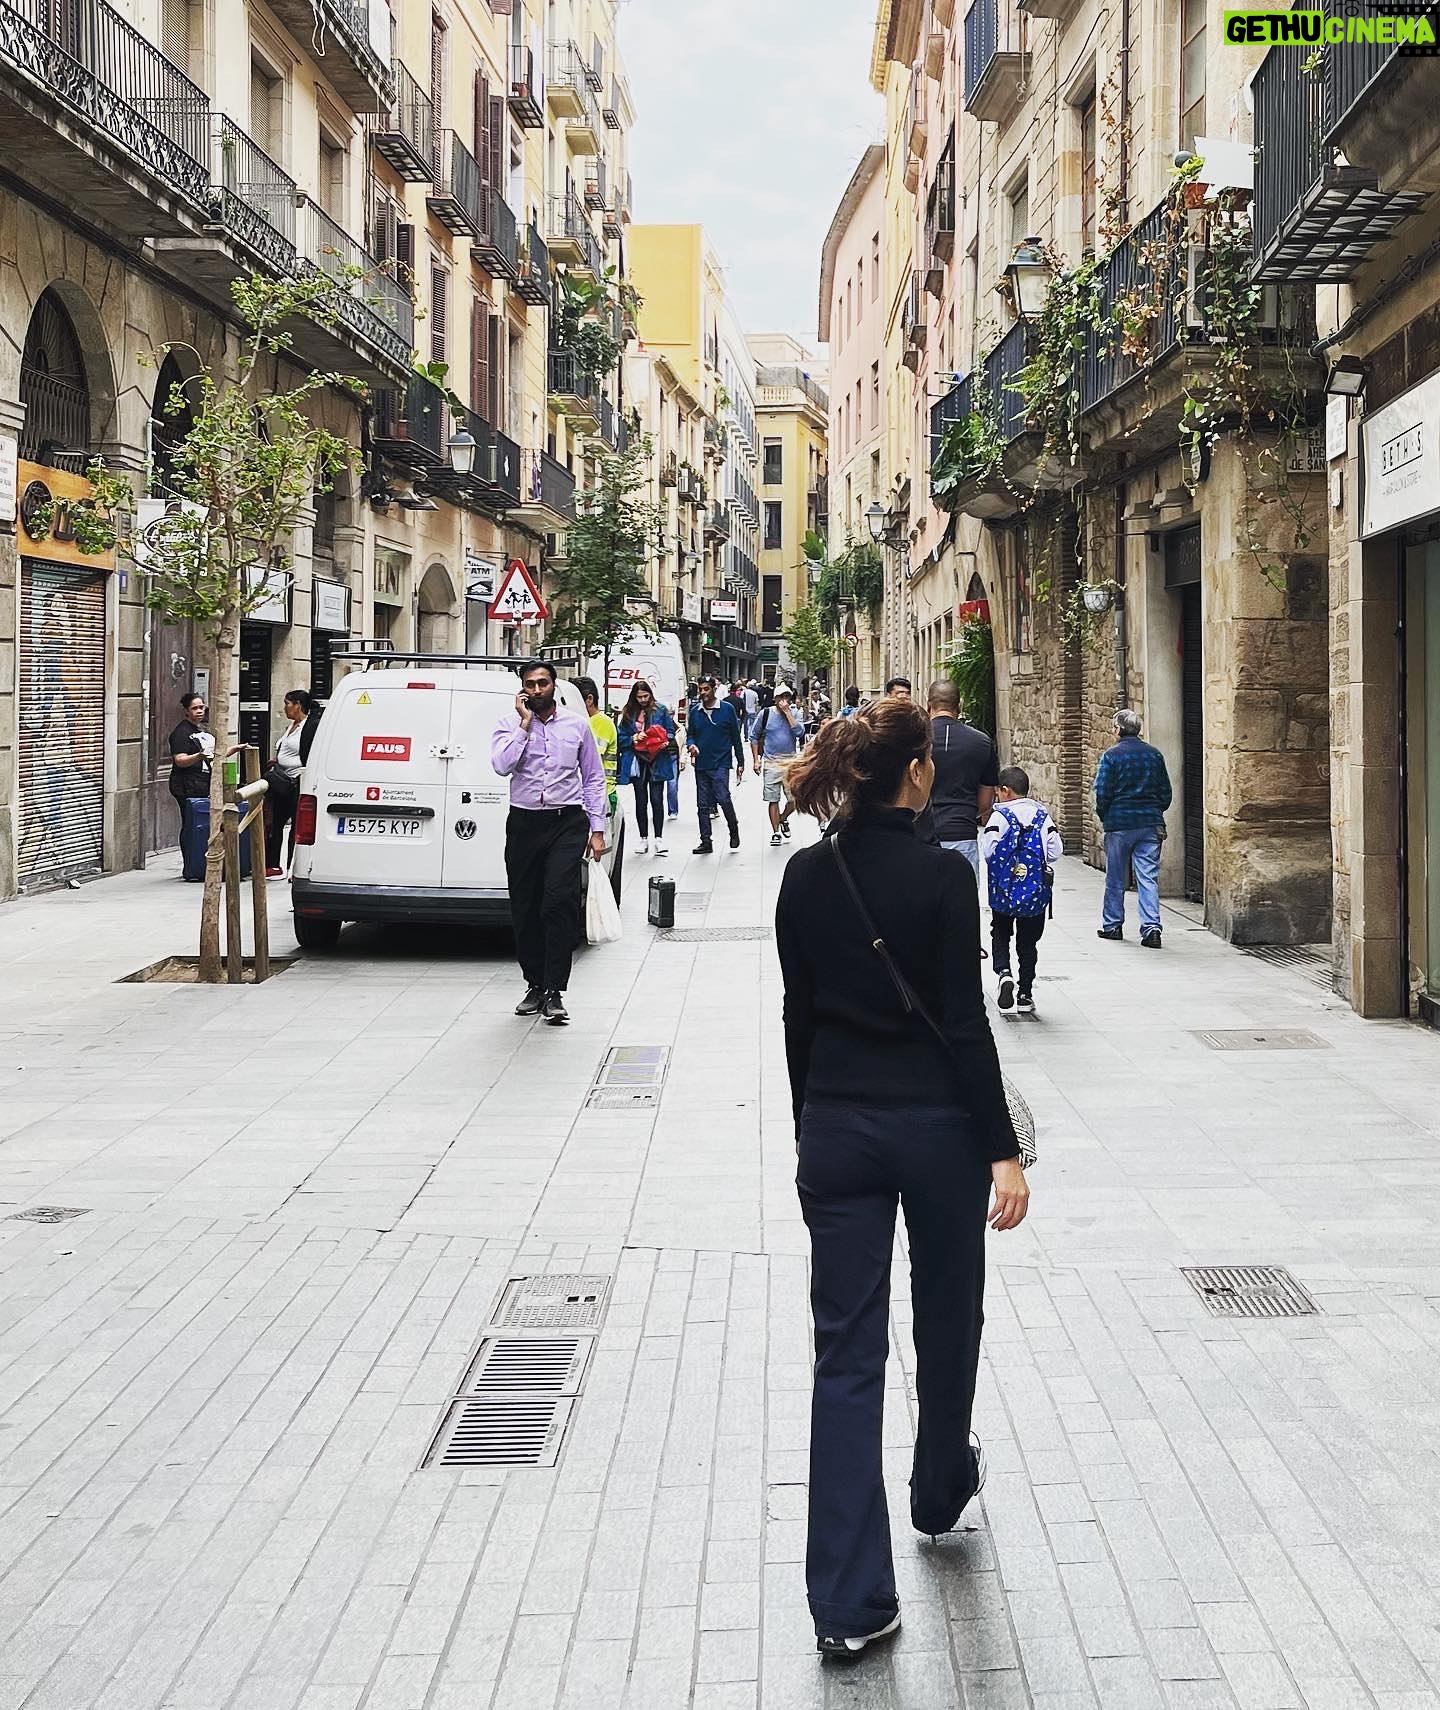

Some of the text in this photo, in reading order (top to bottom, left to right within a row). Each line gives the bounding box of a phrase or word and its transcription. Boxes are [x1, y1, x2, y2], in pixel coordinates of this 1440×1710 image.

[471, 567, 490, 575] ATM
[607, 668, 647, 680] CBL
[366, 743, 406, 754] FAUS
[348, 819, 420, 835] 5575 KYP
